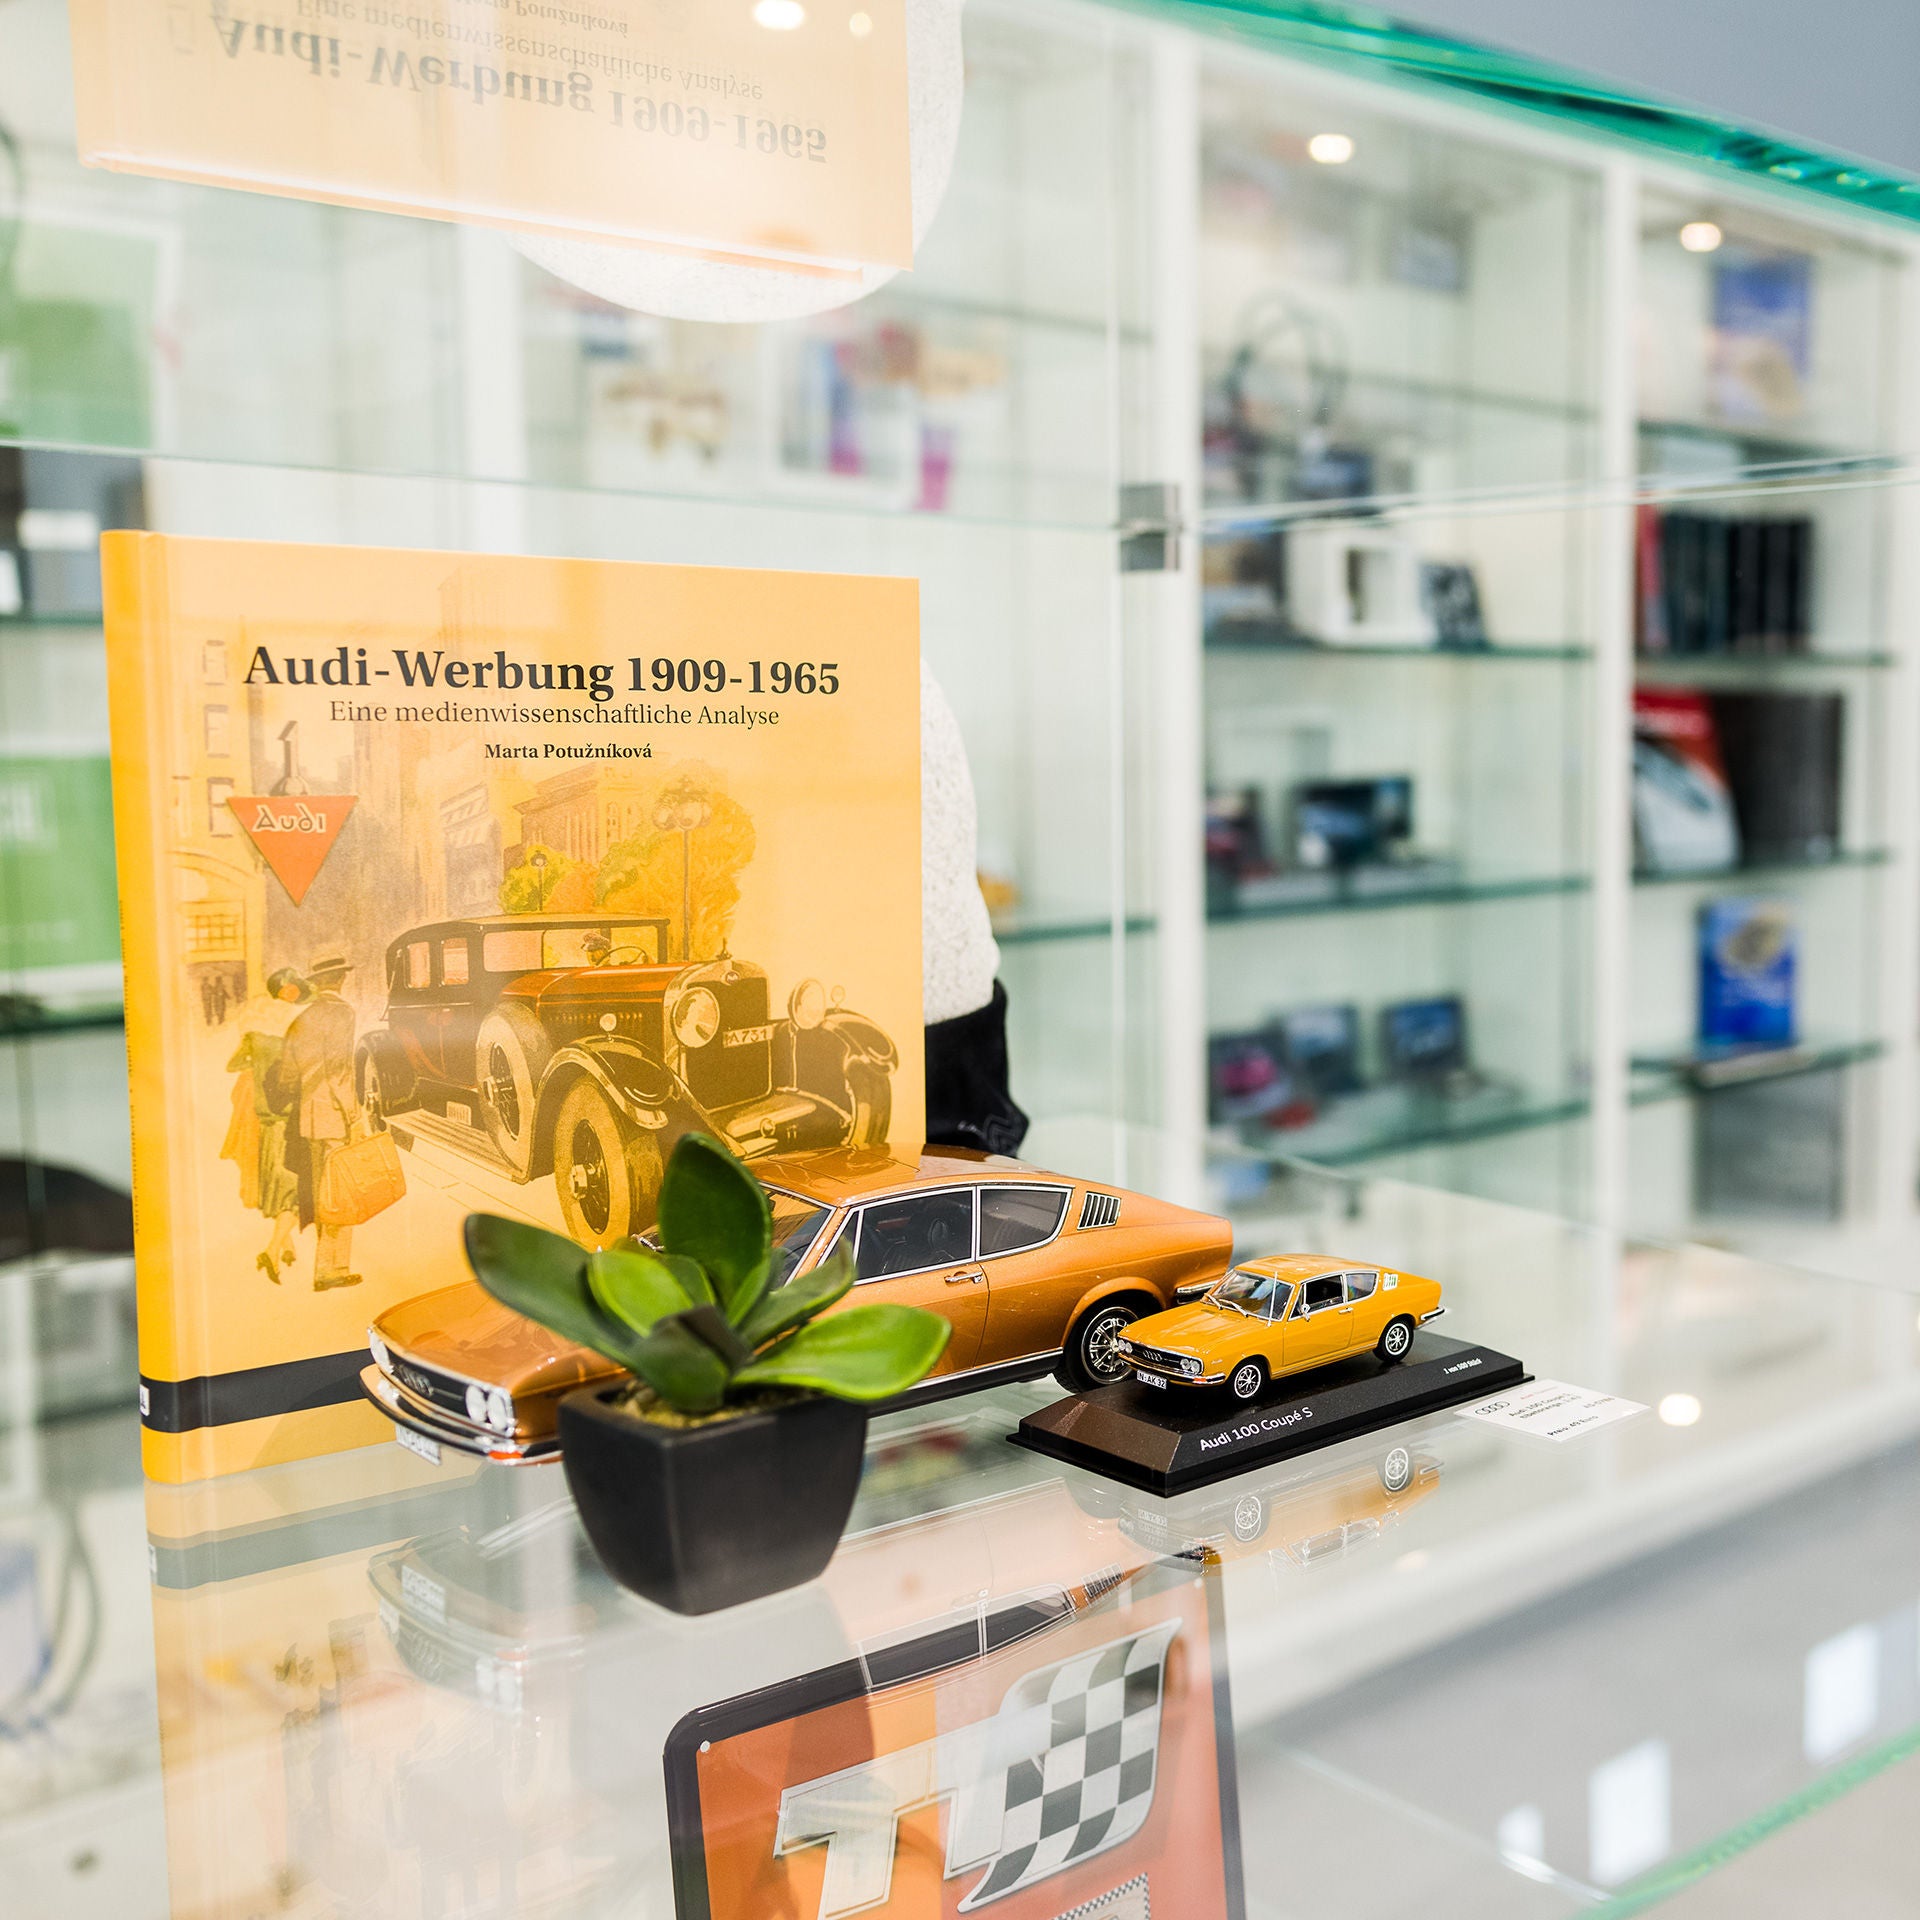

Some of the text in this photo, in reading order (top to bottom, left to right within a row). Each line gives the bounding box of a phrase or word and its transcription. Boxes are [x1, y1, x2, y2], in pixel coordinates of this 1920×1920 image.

[243, 646, 840, 702] Audi-Werbung 1909-1965
[330, 700, 780, 730] Eine medienwissenschaftliche Analyse
[484, 743, 653, 760] Marta Potužníková
[252, 802, 328, 834] Audi
[1200, 1406, 1314, 1451] Audi 100 Coupé S
